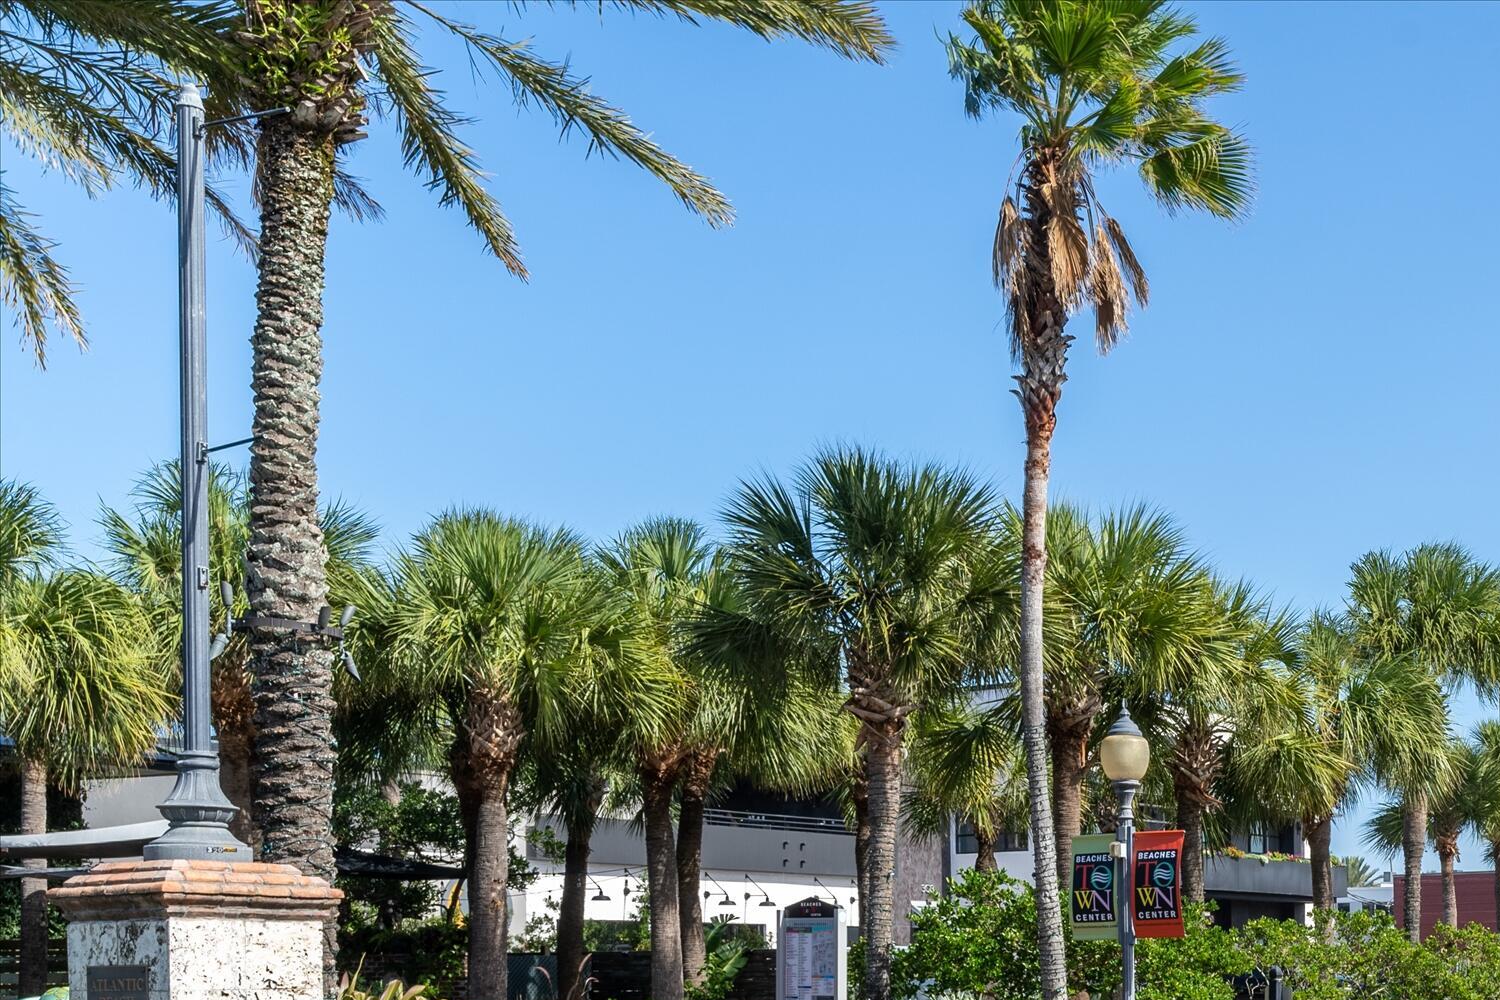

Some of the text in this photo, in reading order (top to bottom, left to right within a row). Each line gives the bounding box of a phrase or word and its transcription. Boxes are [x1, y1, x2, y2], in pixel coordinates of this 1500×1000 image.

[1075, 854, 1113, 863] BEACHES
[1137, 850, 1176, 860] BEACHES
[1075, 913, 1113, 922] CENTER
[1138, 910, 1177, 919] CENTER
[91, 978, 144, 992] ATLANTIC
